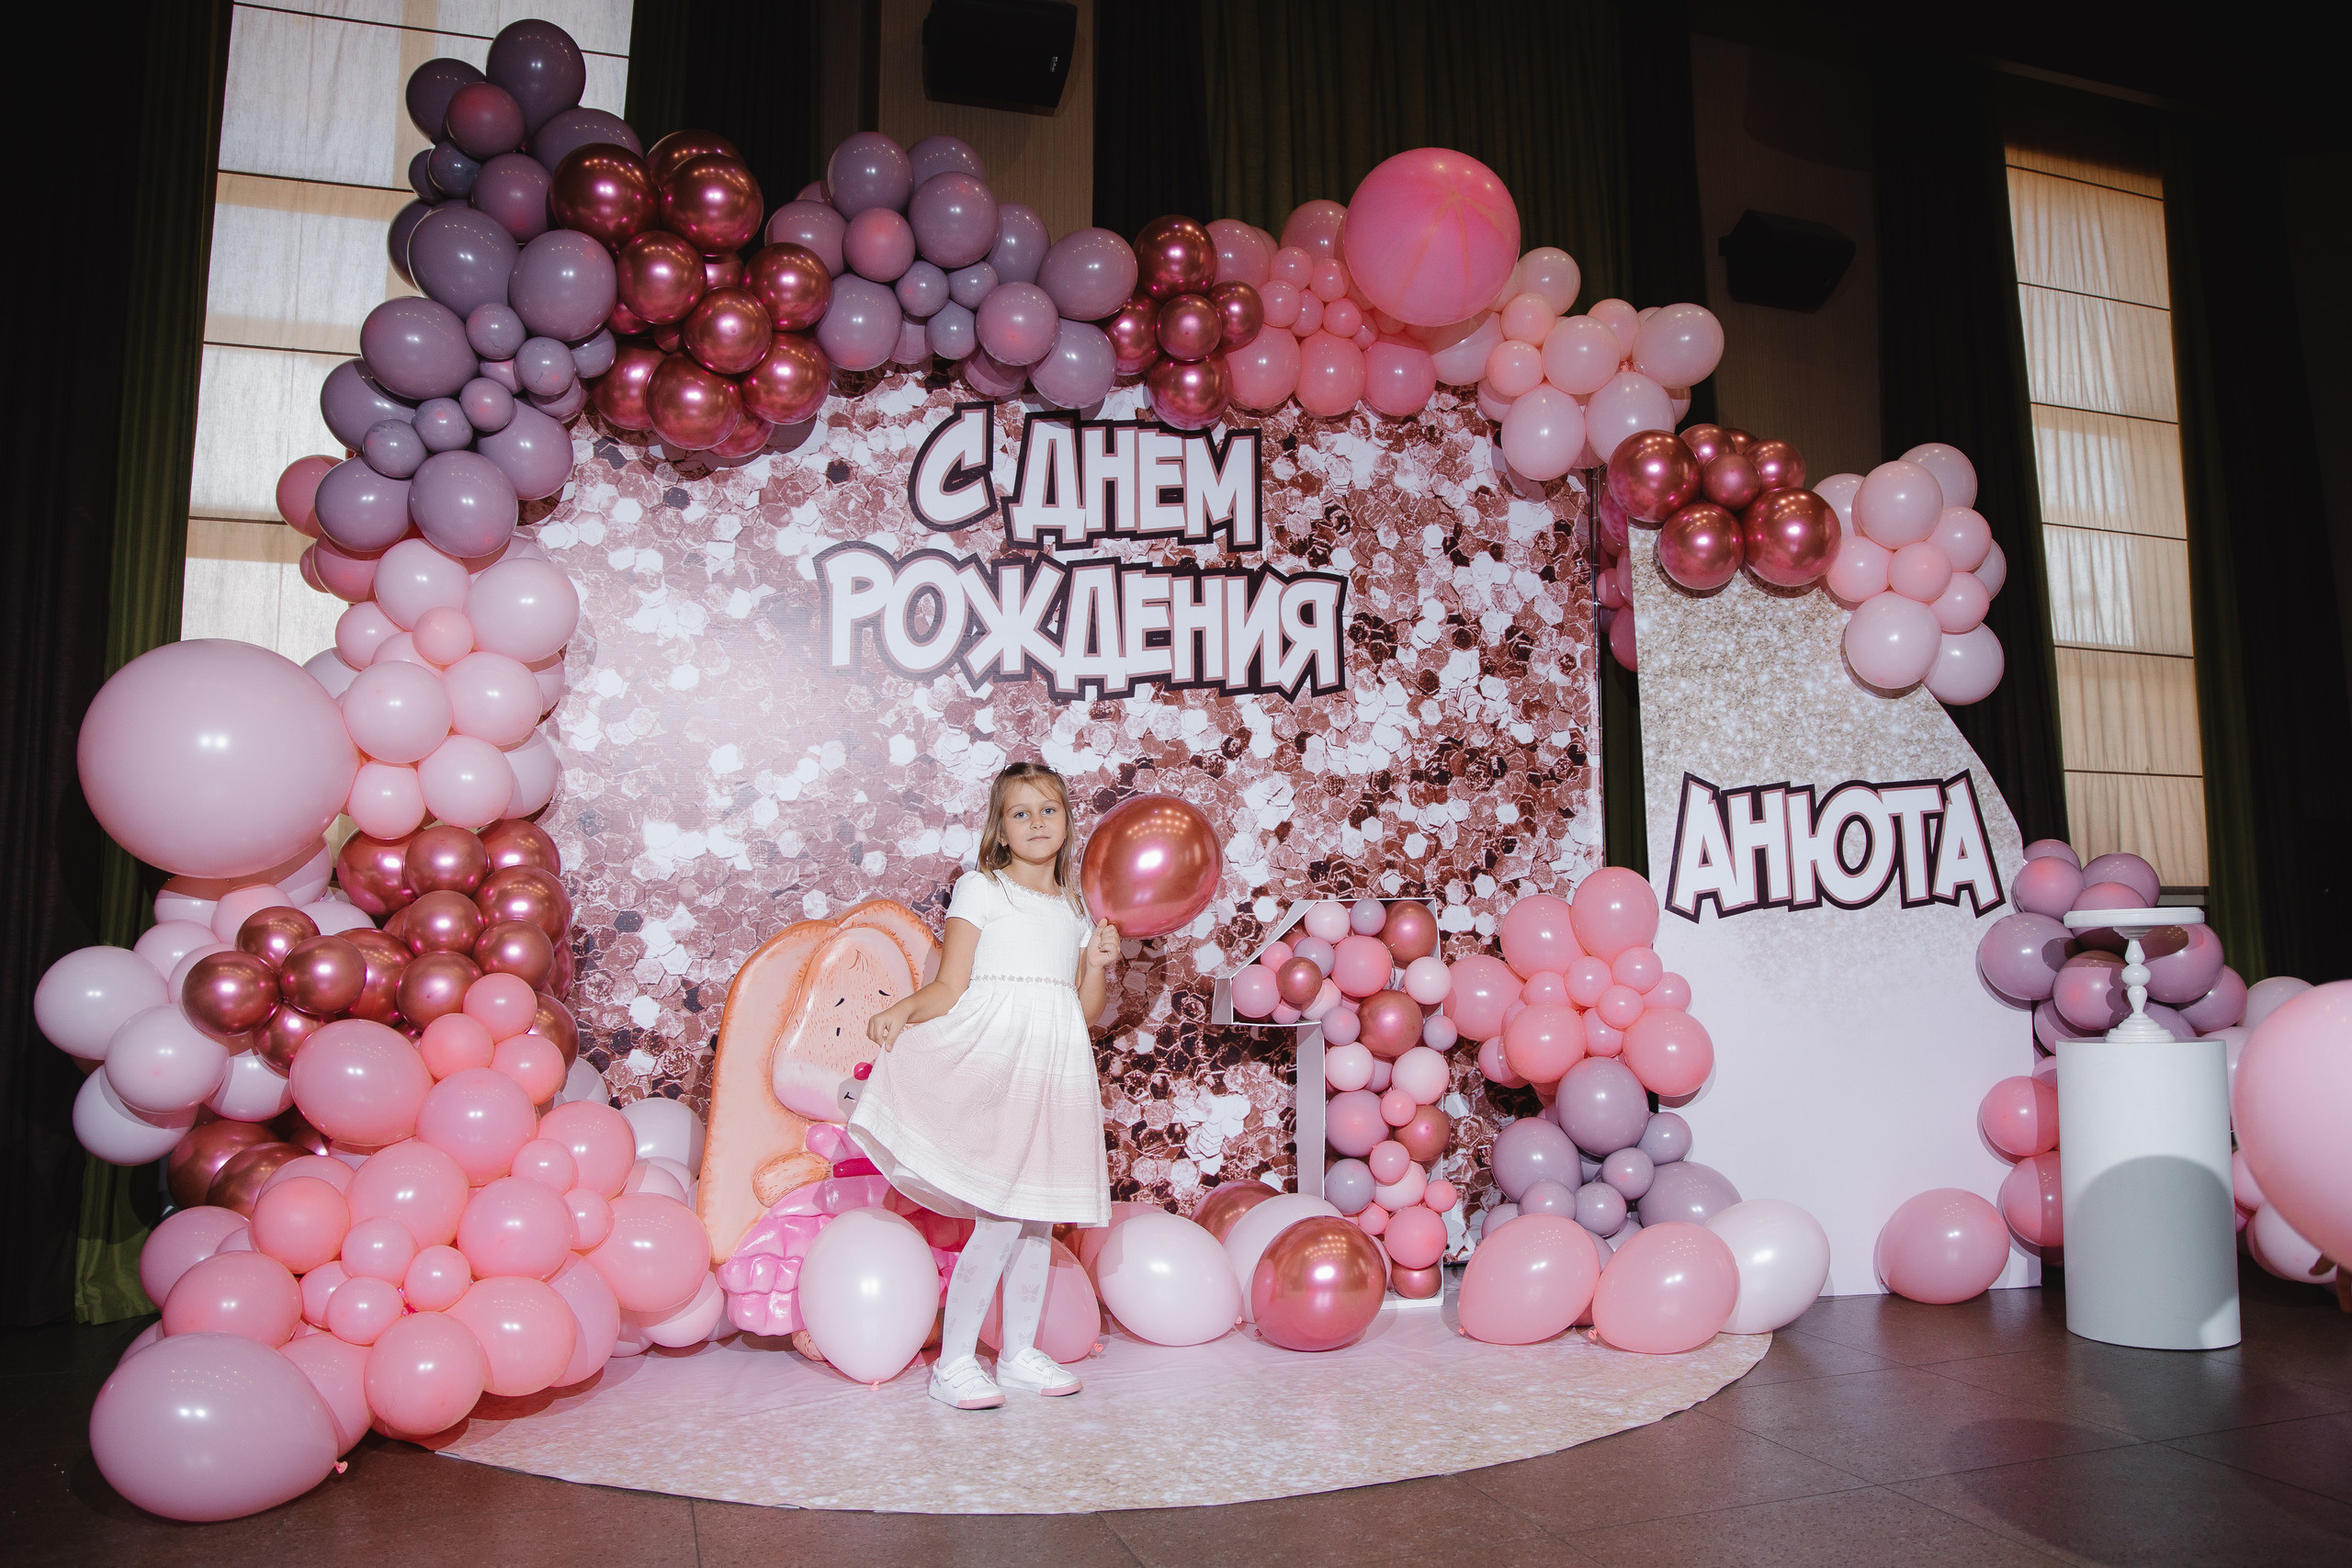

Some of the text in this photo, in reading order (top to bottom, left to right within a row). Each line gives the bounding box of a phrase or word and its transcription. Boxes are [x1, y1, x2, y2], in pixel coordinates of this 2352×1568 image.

[909, 402, 1261, 551] С ДНЕМ
[813, 541, 1348, 703] РОЖДЕНИЯ
[1665, 769, 2006, 923] АНЮТА
